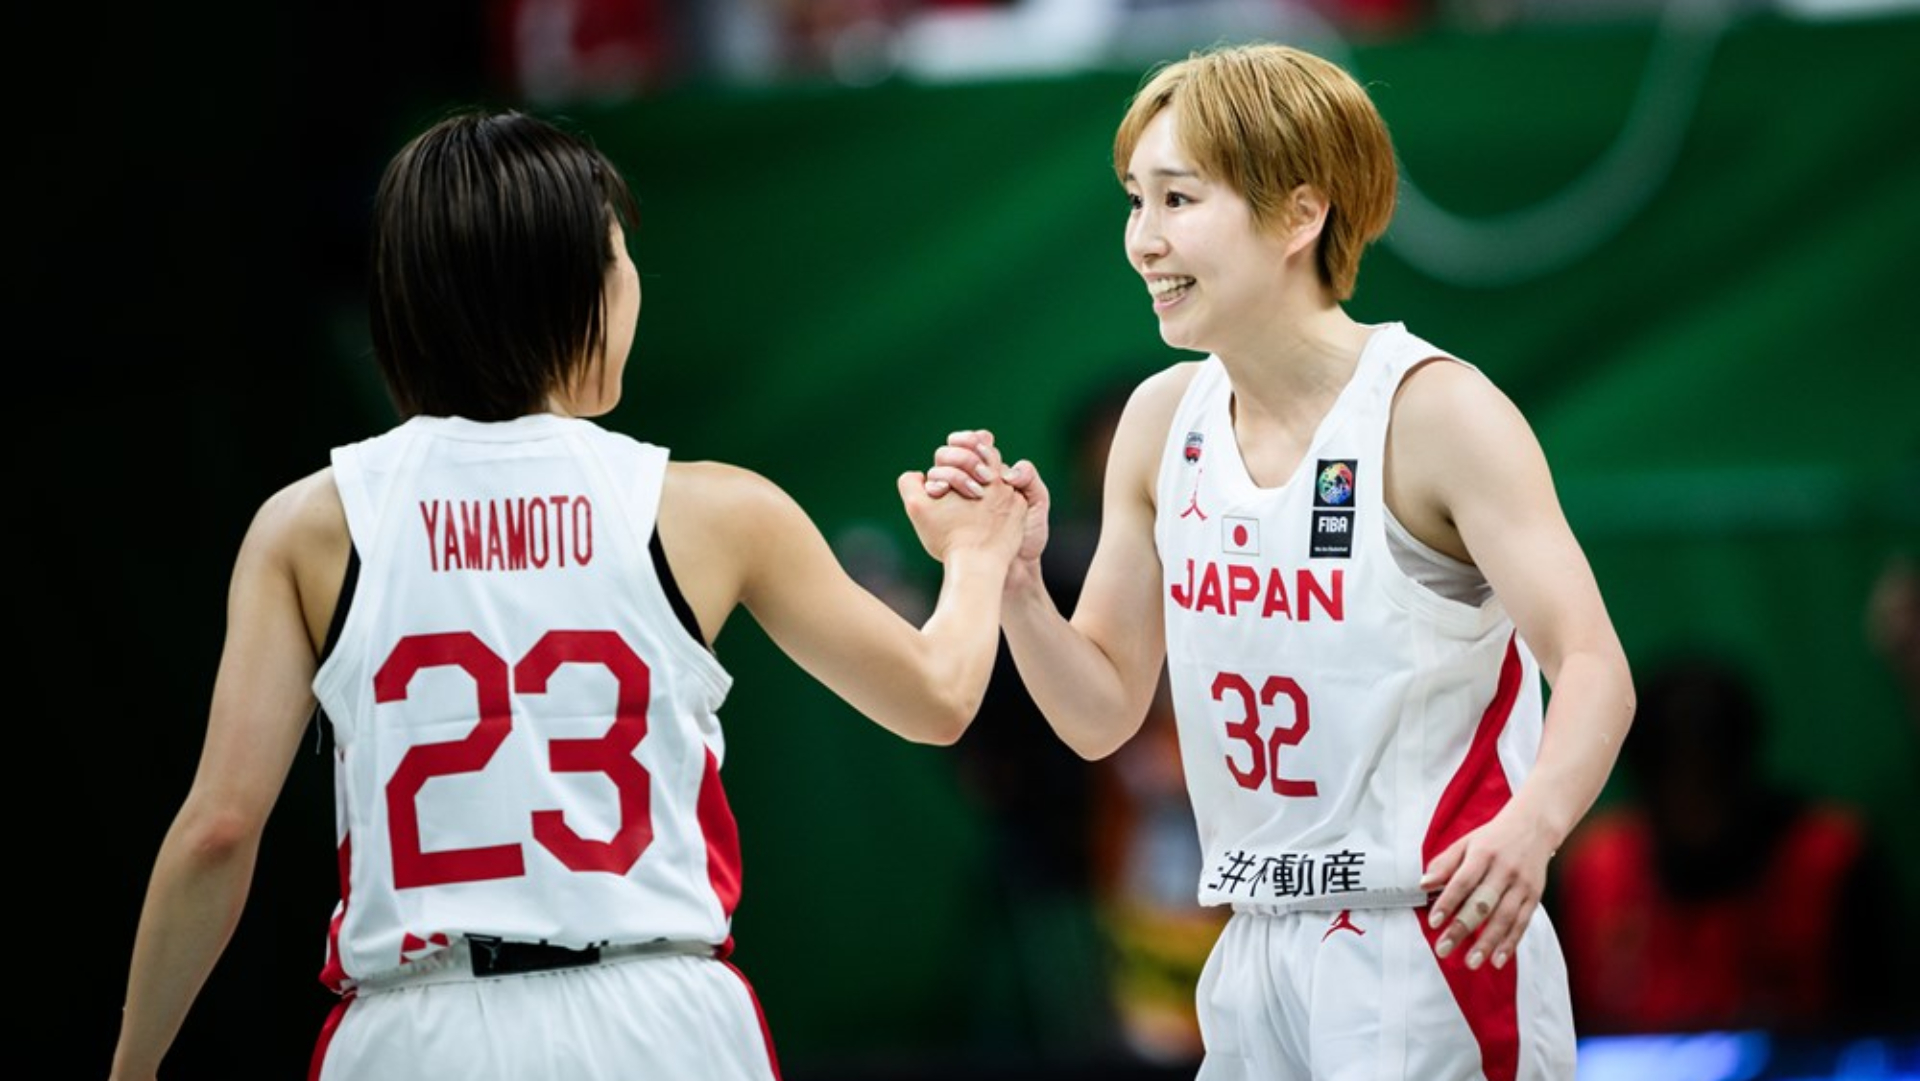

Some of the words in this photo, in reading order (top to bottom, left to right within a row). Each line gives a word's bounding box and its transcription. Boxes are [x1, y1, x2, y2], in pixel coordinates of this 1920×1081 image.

[421, 496, 592, 571] YAMAMOTO
[1318, 516, 1348, 533] FIBA
[1170, 559, 1344, 622] JAPAN
[374, 630, 654, 890] 23
[1211, 671, 1318, 798] 32
